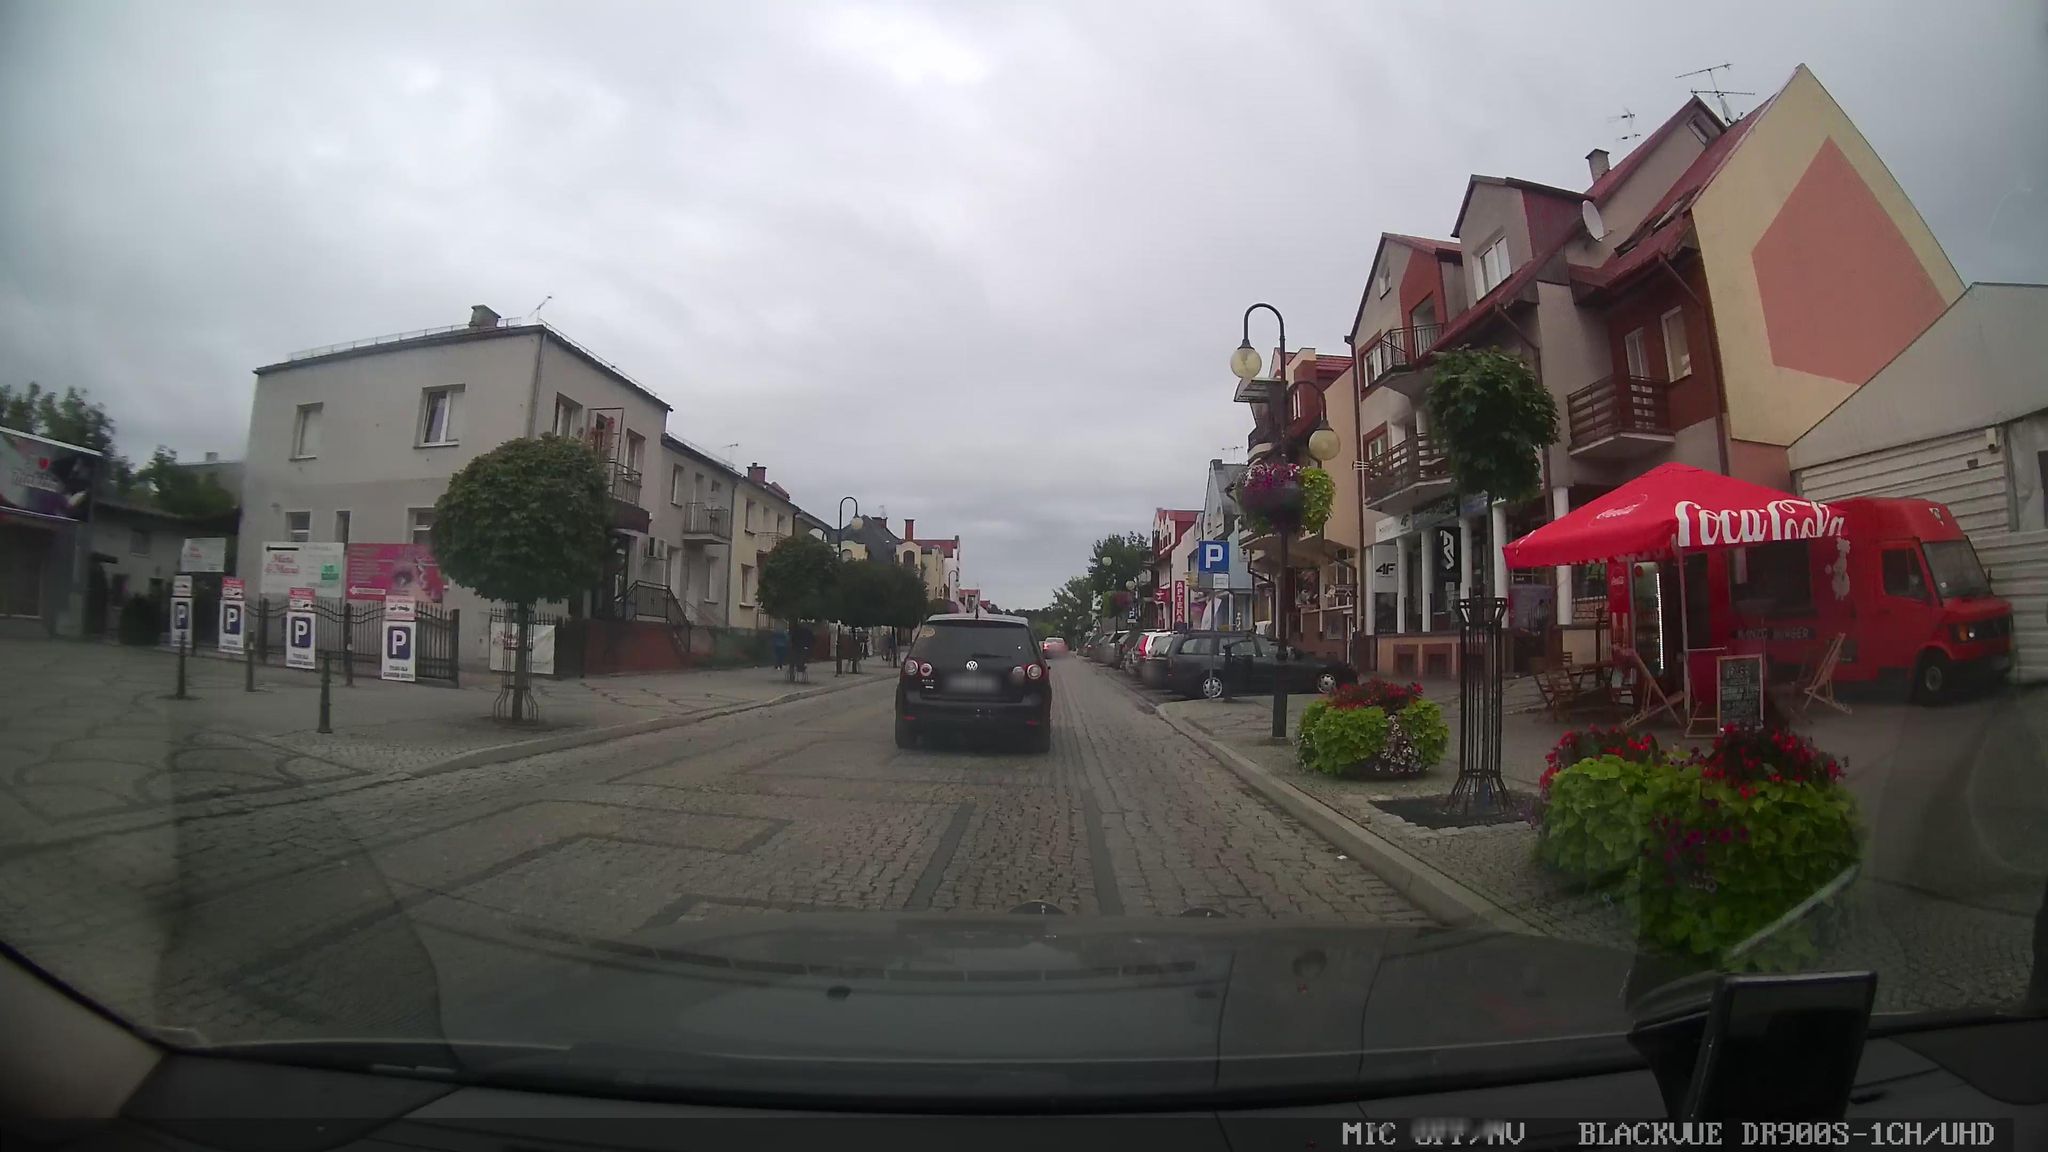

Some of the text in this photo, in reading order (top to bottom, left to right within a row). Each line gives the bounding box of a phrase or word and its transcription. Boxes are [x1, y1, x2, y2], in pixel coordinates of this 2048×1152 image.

[1205, 543, 1224, 569] P
[1375, 562, 1396, 576] 4F
[1174, 581, 1185, 622] APTEKA
[177, 604, 186, 625] P
[226, 608, 239, 631] P
[294, 620, 308, 644] P
[391, 630, 407, 655] P
